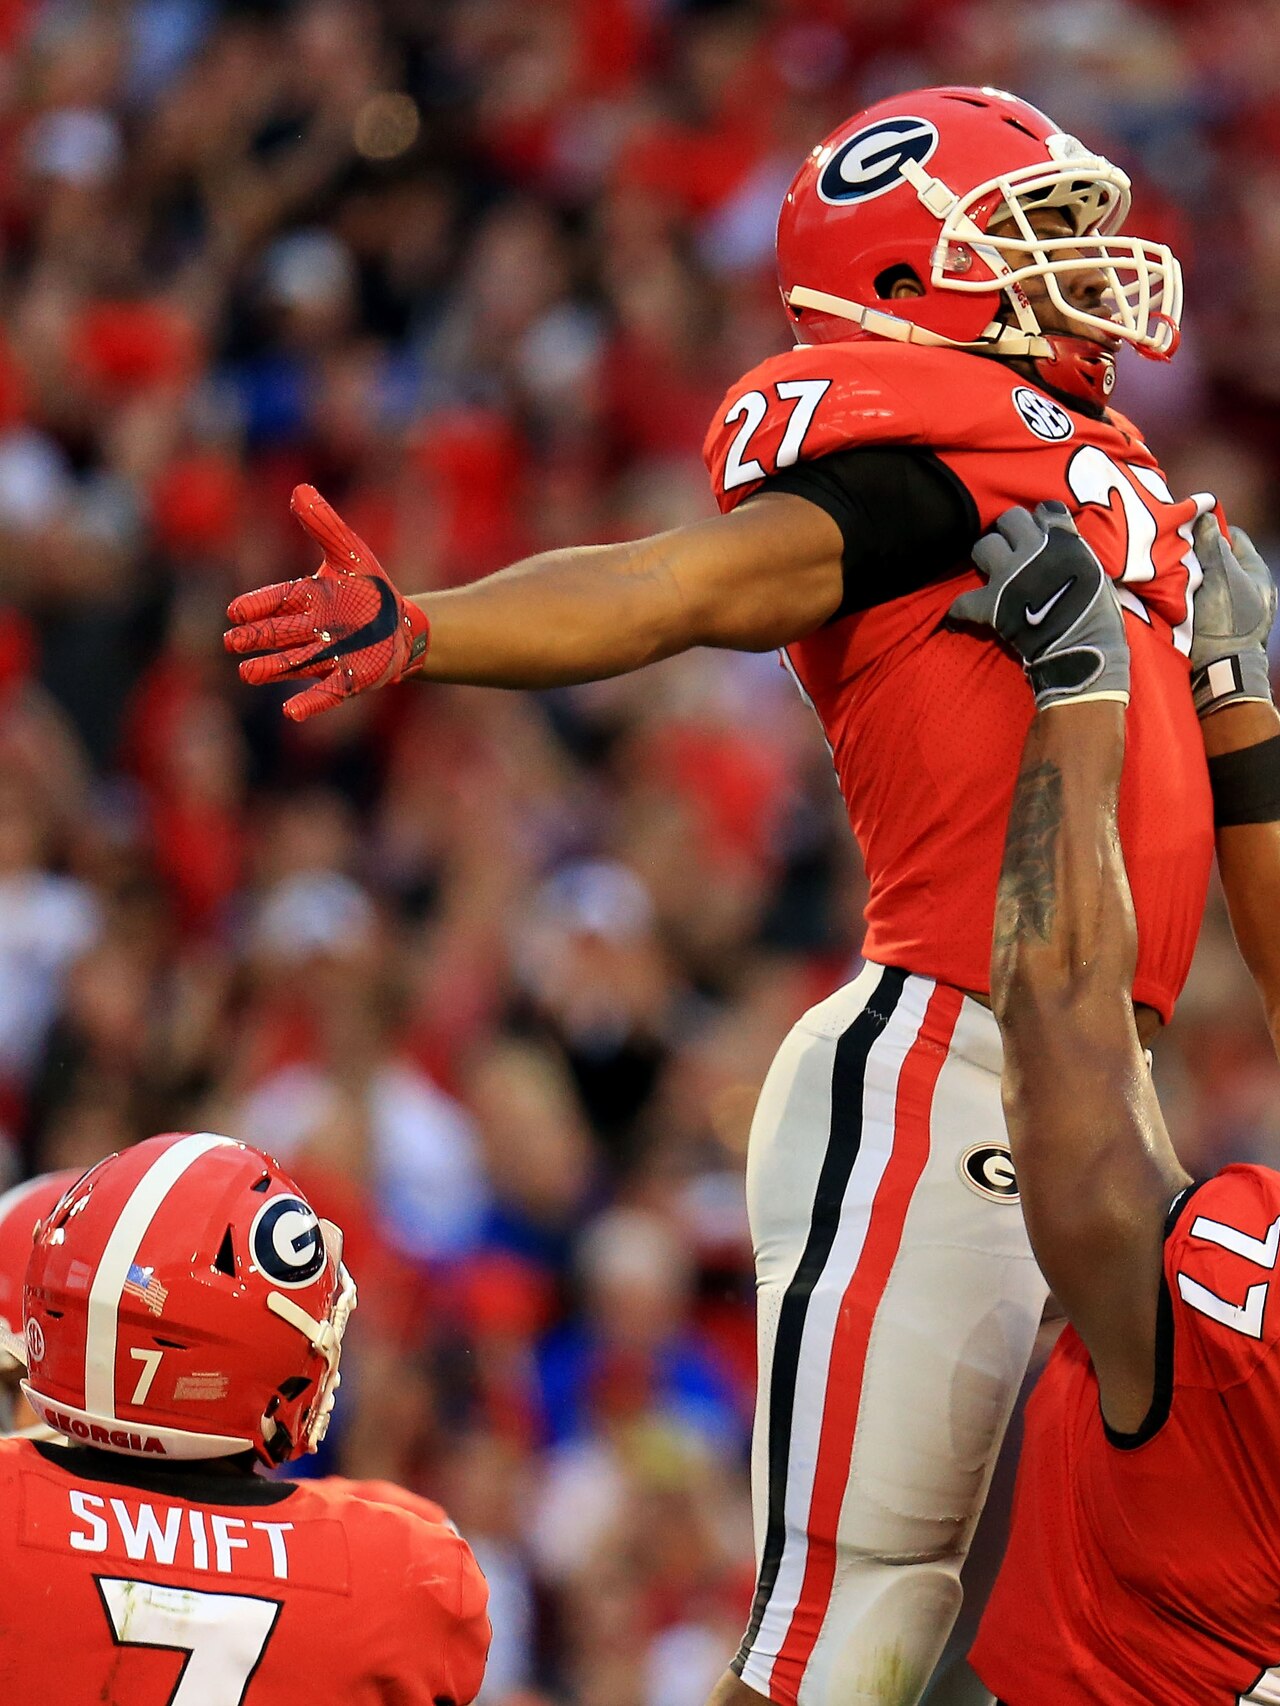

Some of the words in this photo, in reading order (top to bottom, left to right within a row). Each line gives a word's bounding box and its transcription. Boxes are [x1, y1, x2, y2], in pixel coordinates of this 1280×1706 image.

[819, 117, 937, 204] G
[724, 379, 831, 491] 27
[250, 1194, 326, 1288] G
[130, 1347, 163, 1405] 7
[44, 1408, 166, 1454] GEORGIA
[69, 1490, 294, 1579] SWIFT
[92, 1573, 284, 1706] 7
